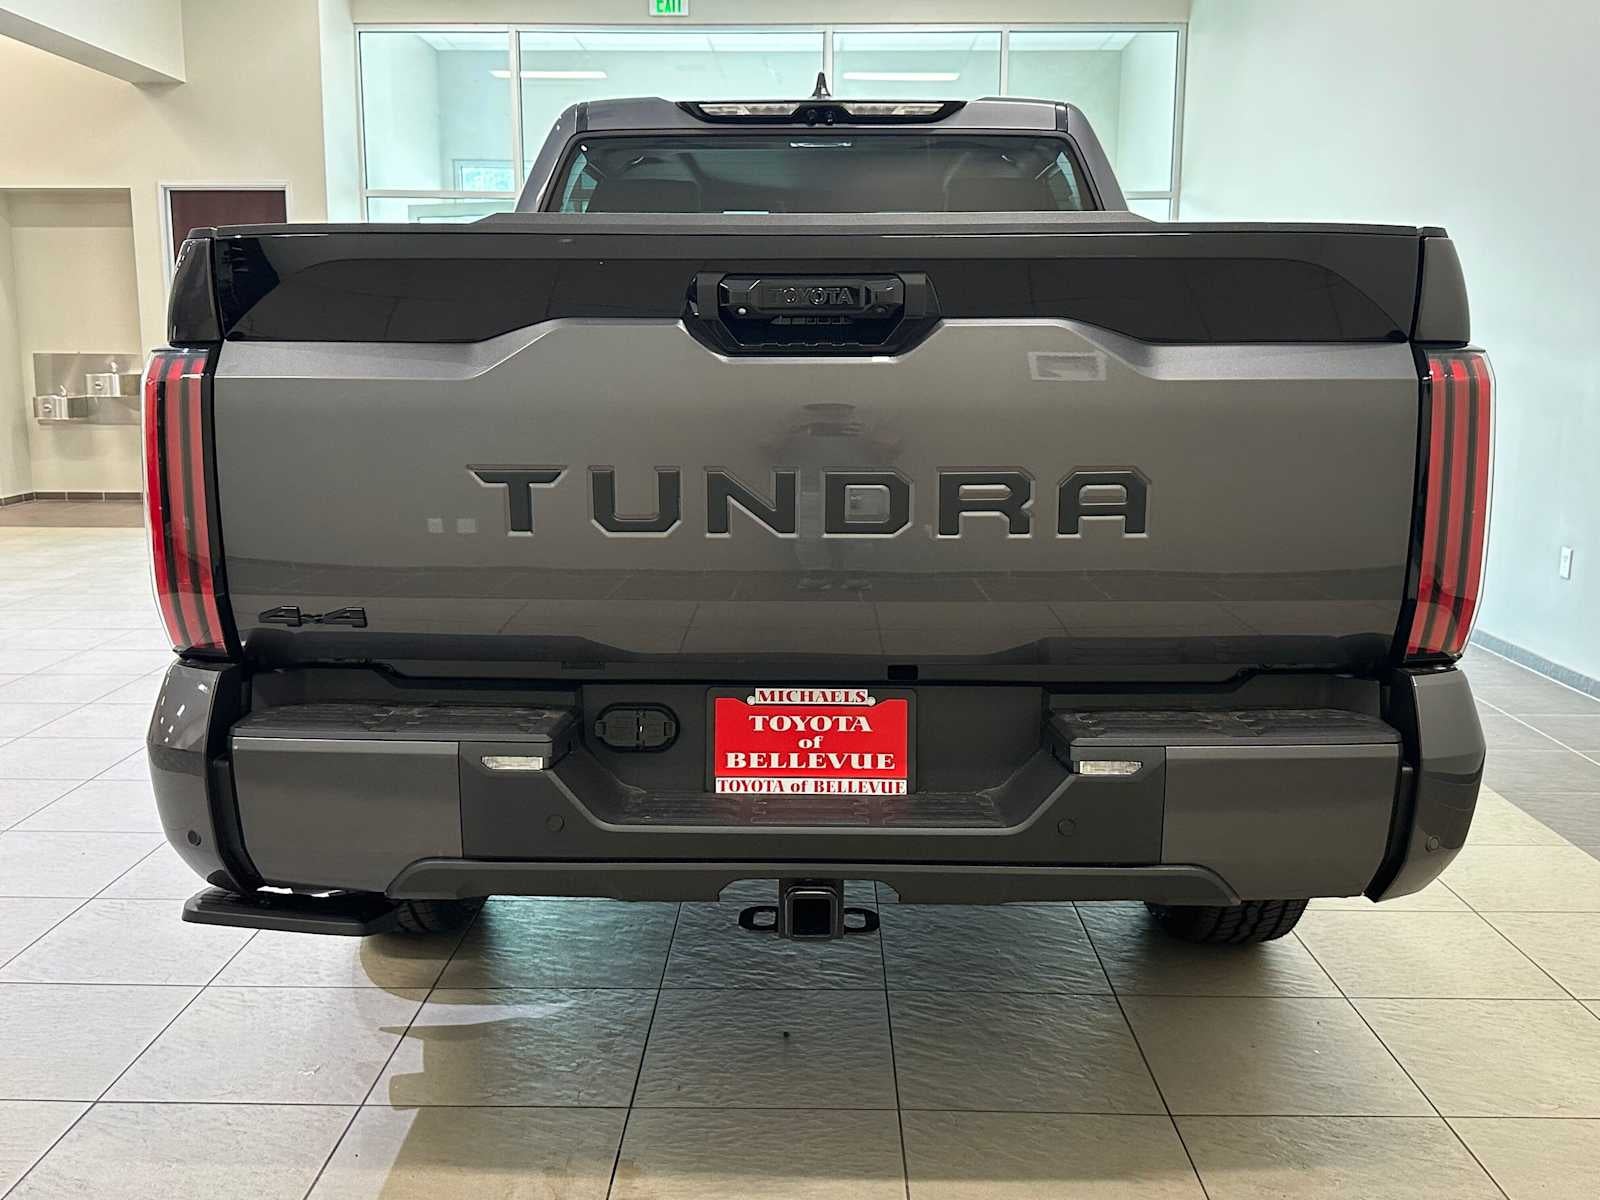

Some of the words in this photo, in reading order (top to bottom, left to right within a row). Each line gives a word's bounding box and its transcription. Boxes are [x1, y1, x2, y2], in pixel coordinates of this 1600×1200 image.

[768, 287, 855, 305] TOYOTA
[467, 465, 1151, 540] TUNDRA
[757, 689, 868, 703] MICHAELS
[749, 715, 873, 732] TOYOTA
[798, 735, 824, 749] of
[725, 752, 896, 770] BELLEVUE
[717, 779, 785, 793] TOYOTA
[790, 780, 809, 793] of
[813, 780, 906, 794] BELLEVUE
